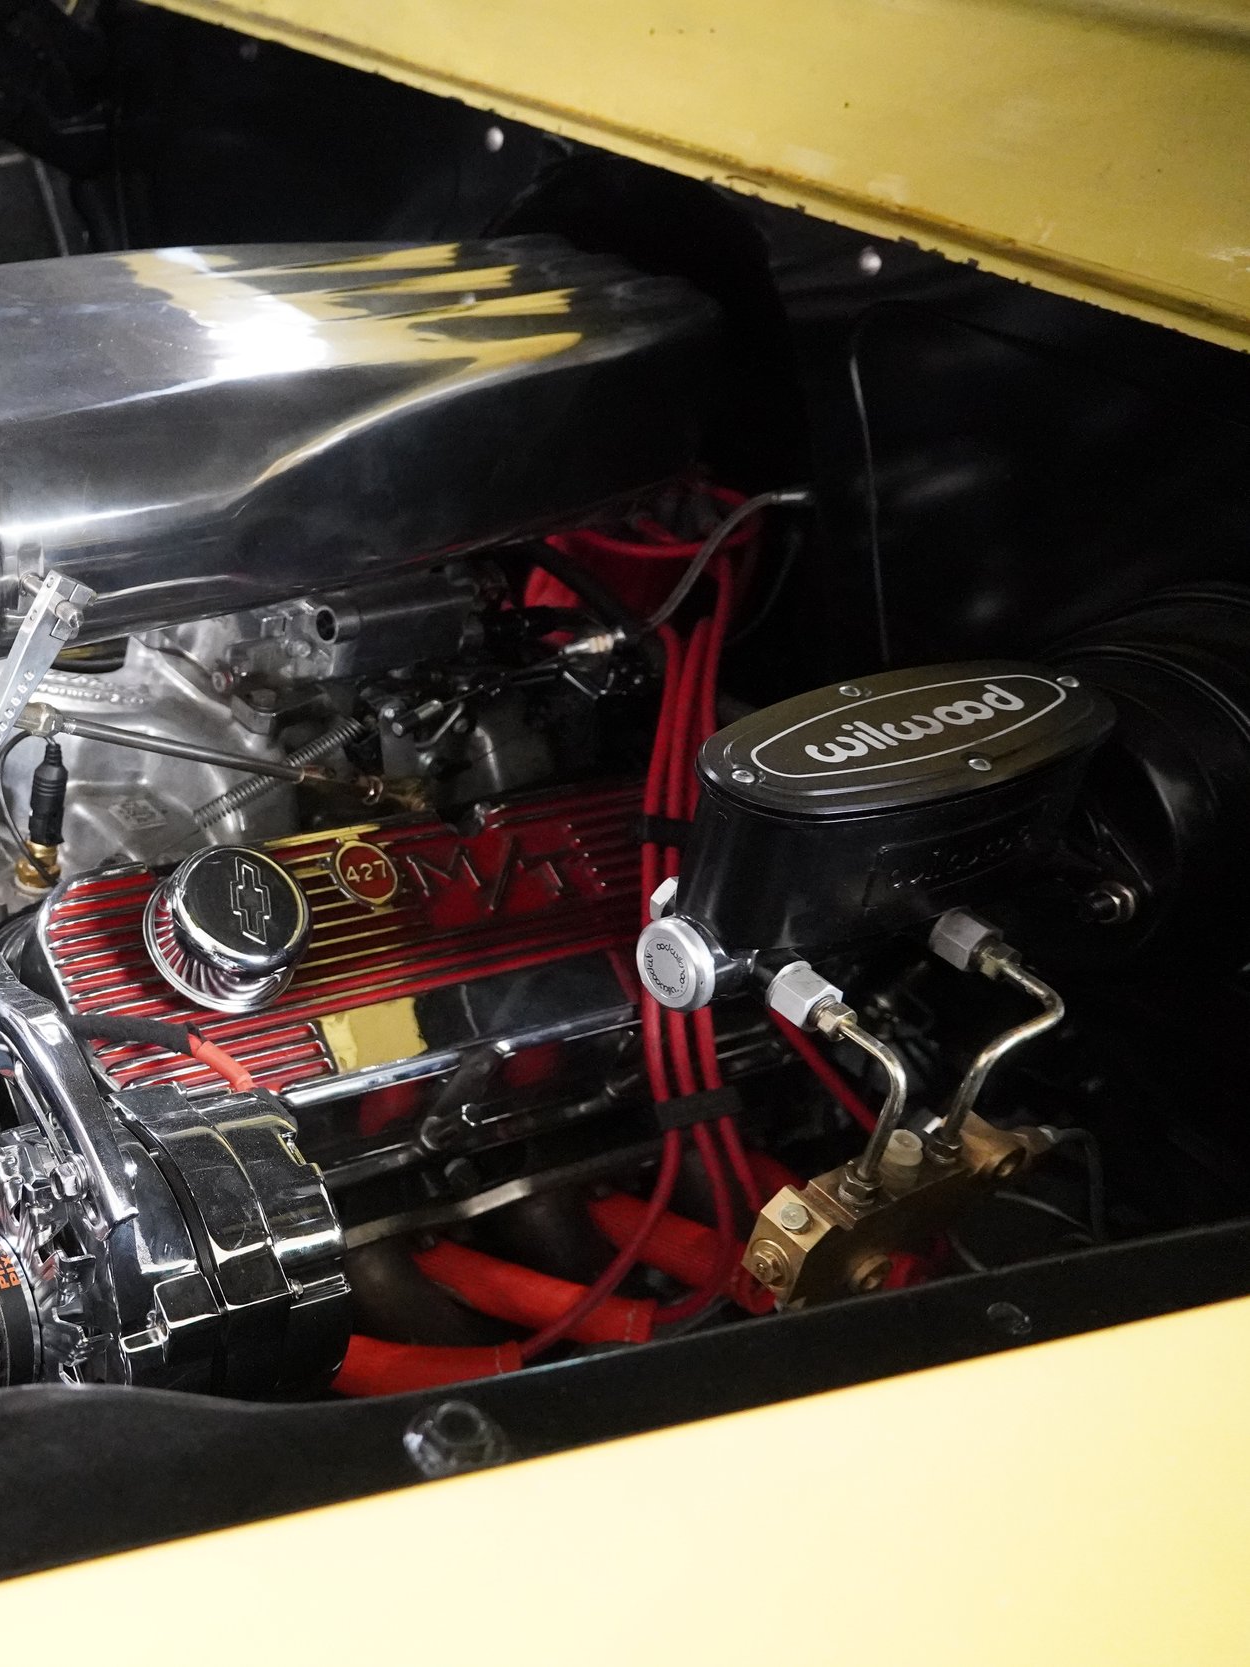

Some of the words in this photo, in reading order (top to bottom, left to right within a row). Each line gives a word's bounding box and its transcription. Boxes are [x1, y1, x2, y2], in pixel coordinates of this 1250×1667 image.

[804, 683, 1025, 763] wilwood
[346, 859, 388, 883] 427
[1, 1252, 21, 1286] PIX
